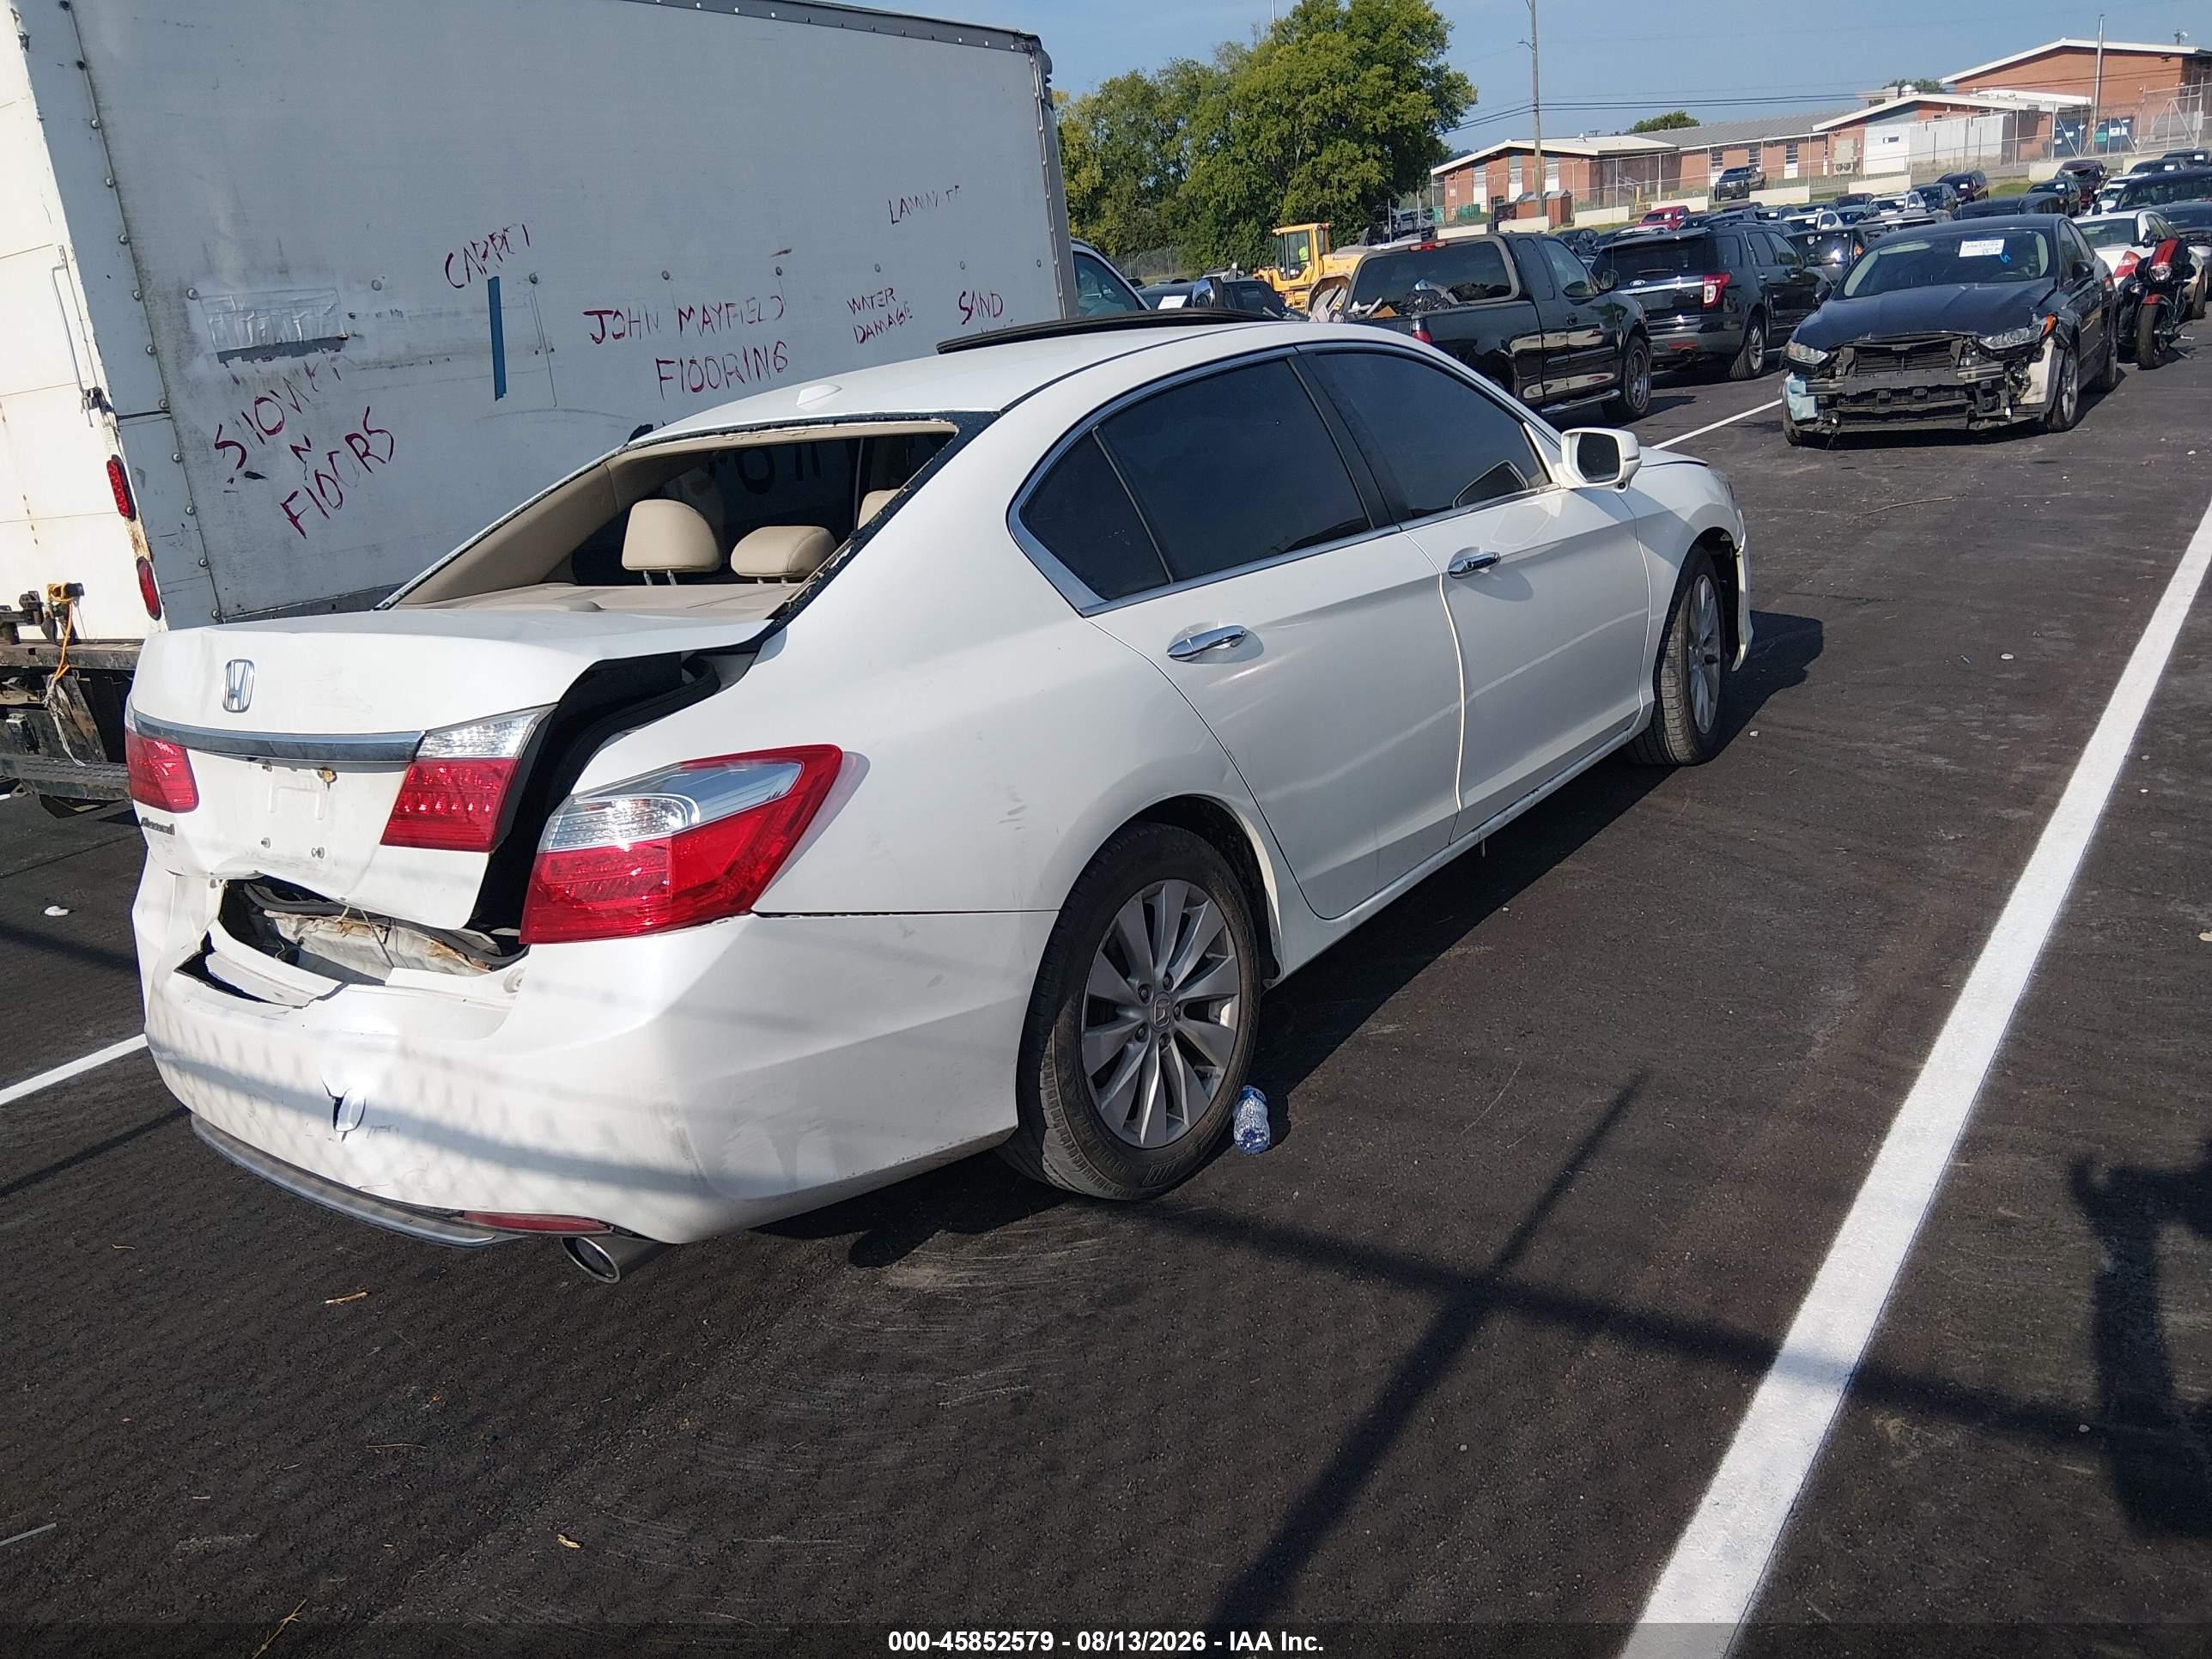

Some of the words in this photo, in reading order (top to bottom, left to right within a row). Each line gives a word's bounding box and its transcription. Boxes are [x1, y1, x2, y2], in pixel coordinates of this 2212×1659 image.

[847, 287, 896, 315] WATER
[958, 290, 1004, 325] SAND
[582, 304, 659, 344] JOHN
[678, 295, 785, 338] MAYFIELD
